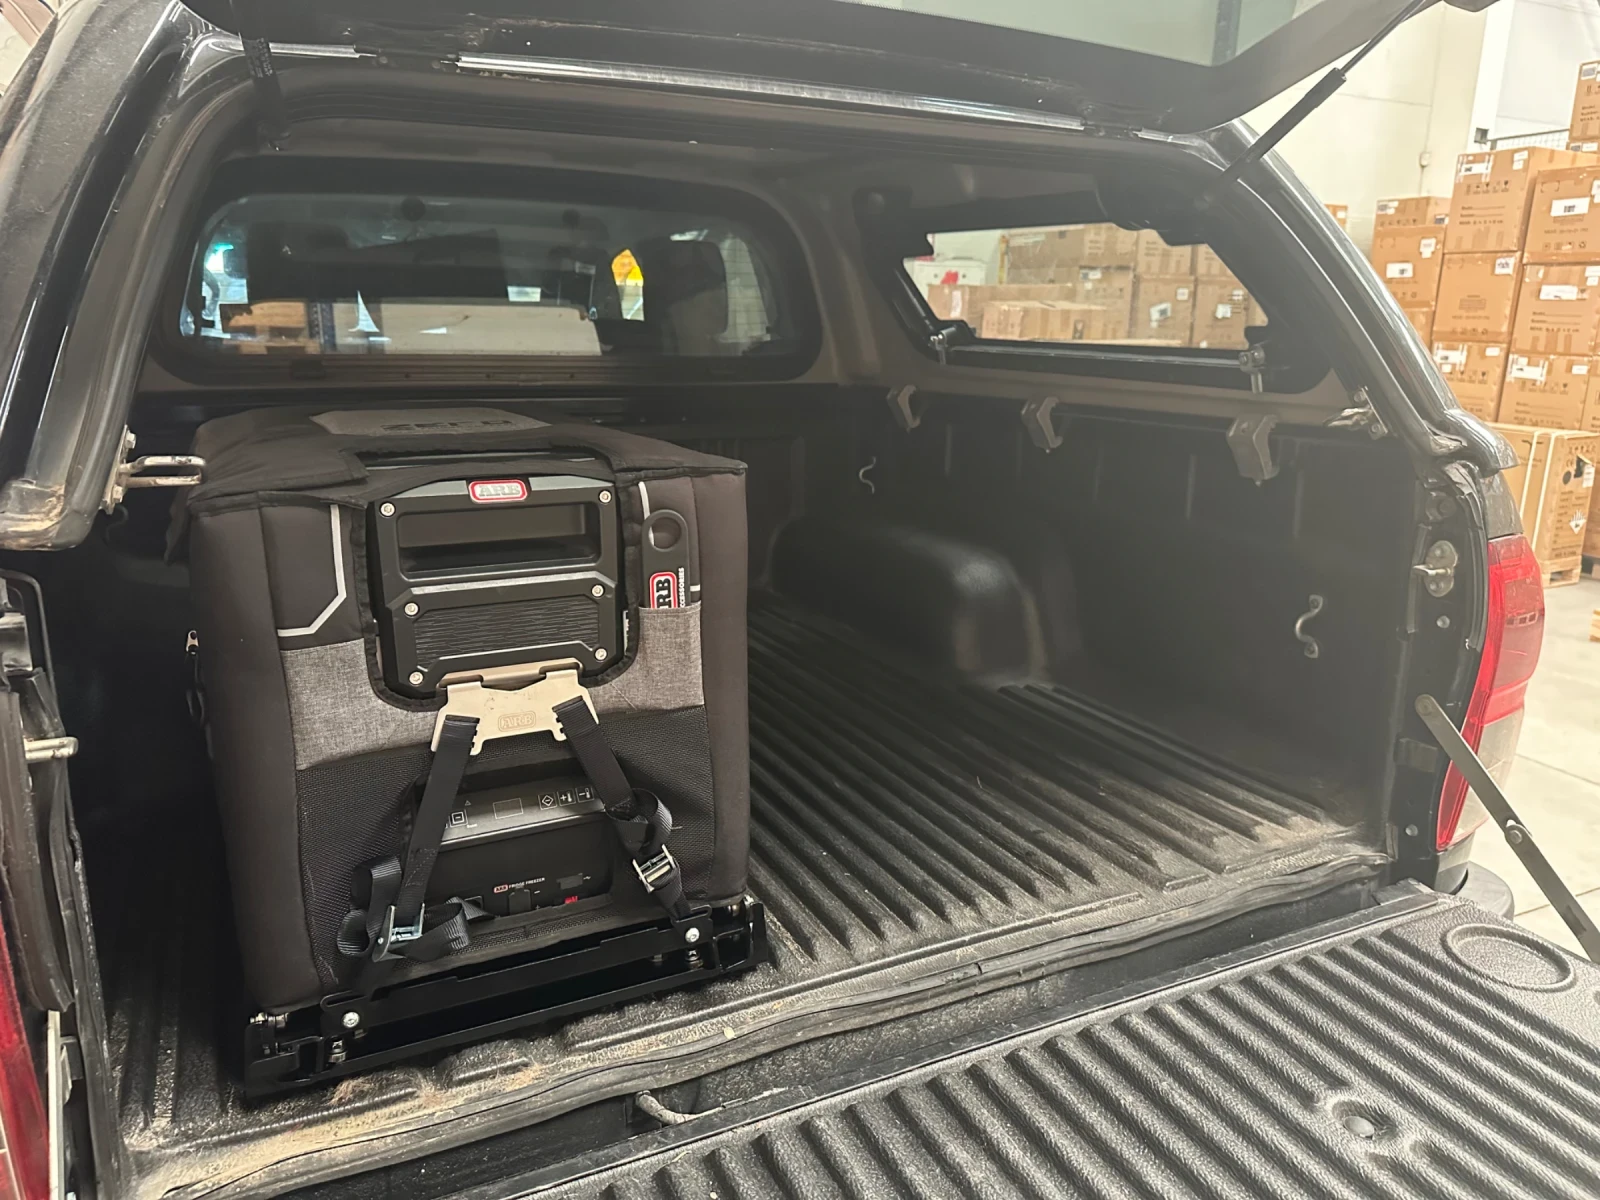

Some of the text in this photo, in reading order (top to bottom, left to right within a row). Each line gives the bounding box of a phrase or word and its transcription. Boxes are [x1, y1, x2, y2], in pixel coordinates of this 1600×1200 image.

[478, 484, 521, 497] ARB
[655, 578, 672, 608] RB
[502, 713, 534, 729] ARB
